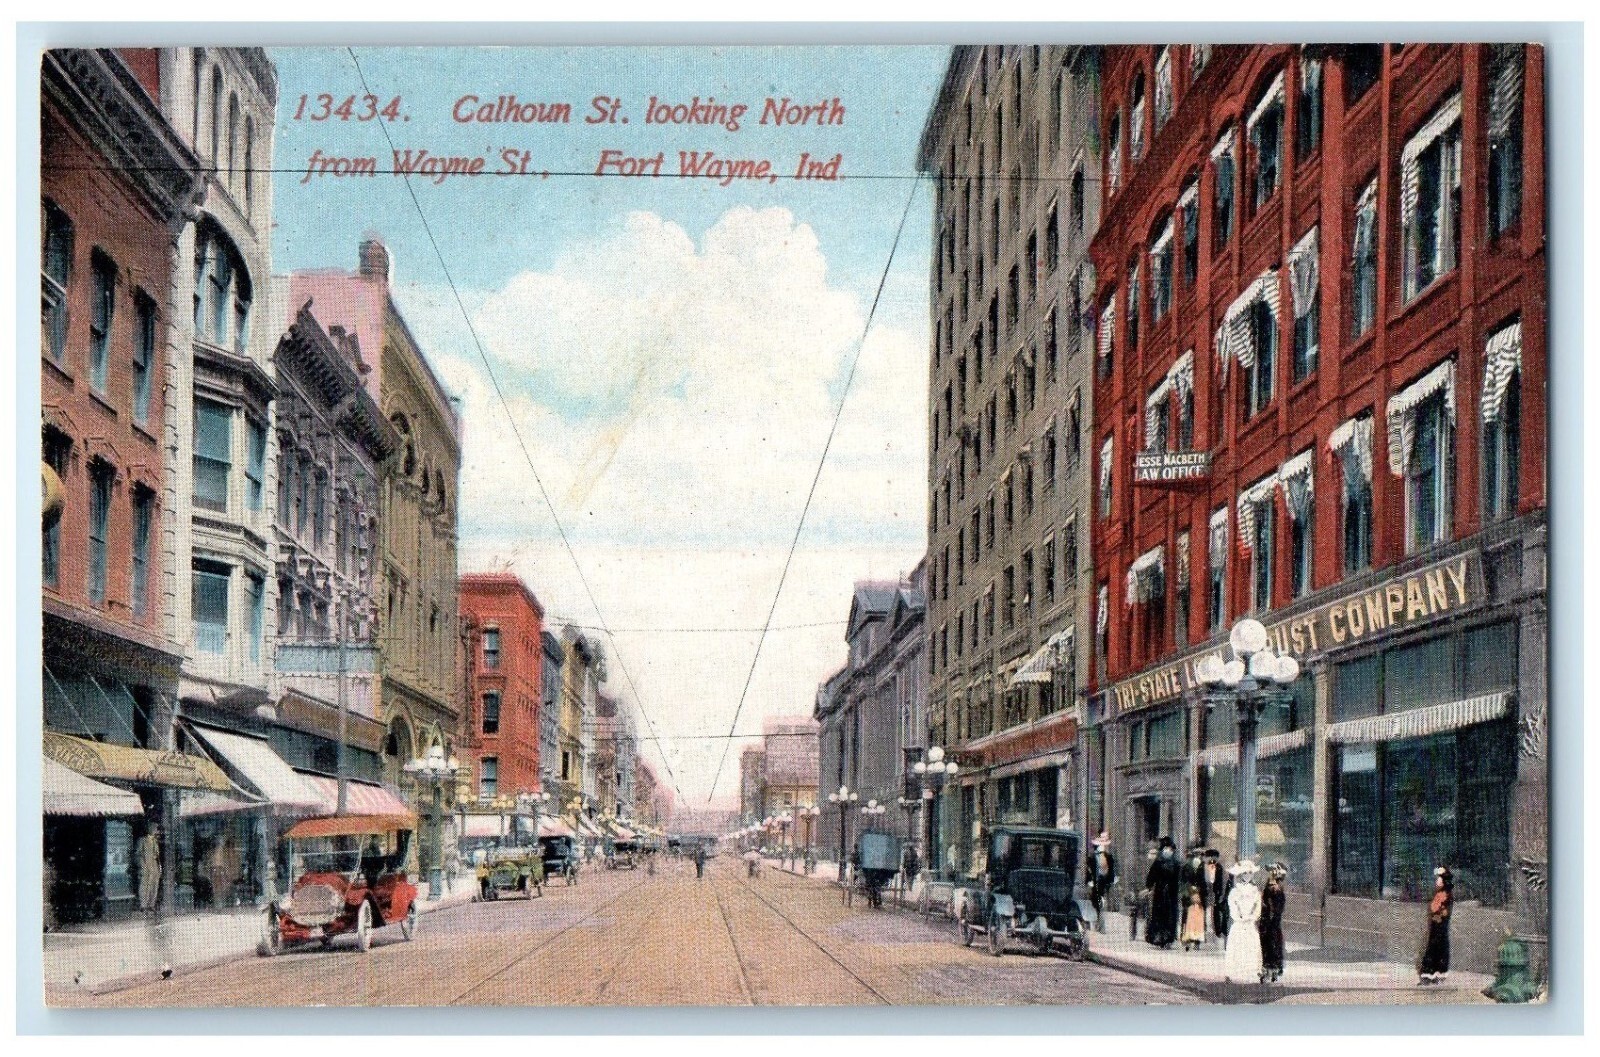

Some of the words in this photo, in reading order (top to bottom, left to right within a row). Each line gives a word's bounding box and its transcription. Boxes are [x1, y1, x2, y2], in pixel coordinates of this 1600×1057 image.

[1133, 453, 1161, 467] JESSE
[1134, 467, 1160, 481] LAW
[1162, 465, 1204, 480] OFFICE
[1115, 667, 1181, 710] TRI-STATE
[1329, 559, 1467, 643] COMPANY
